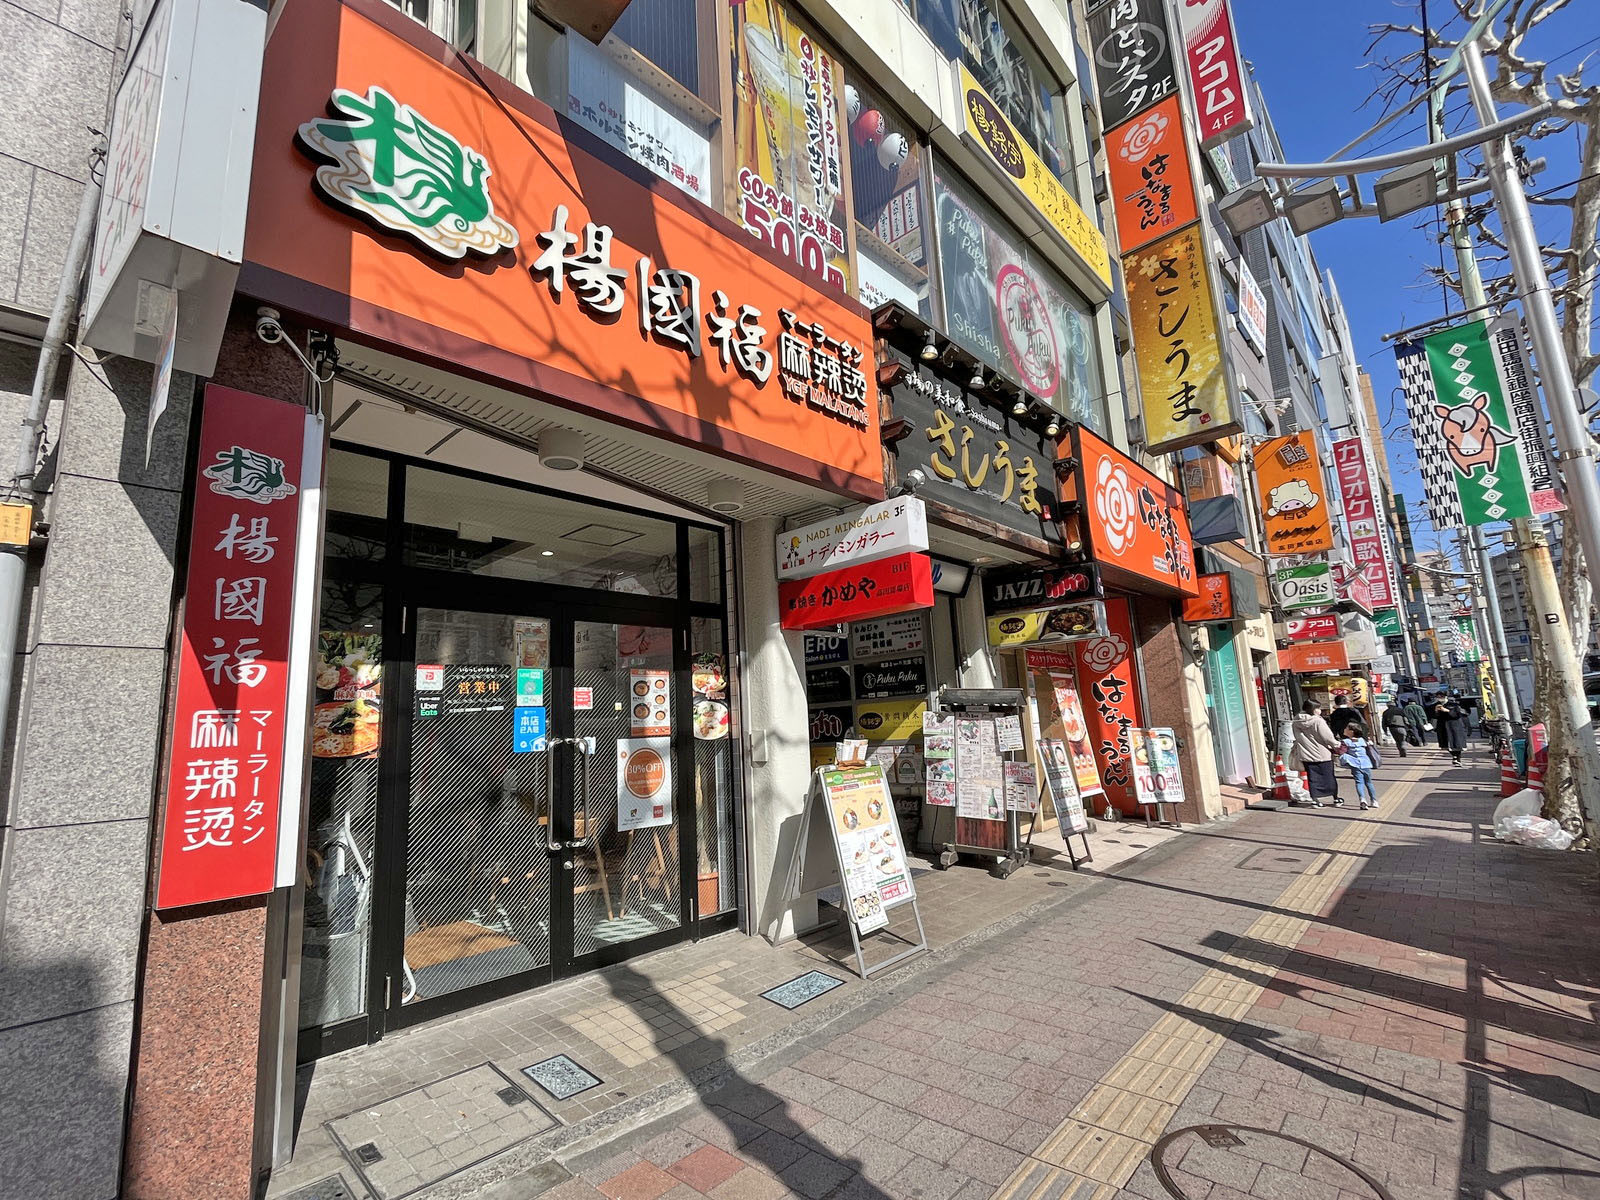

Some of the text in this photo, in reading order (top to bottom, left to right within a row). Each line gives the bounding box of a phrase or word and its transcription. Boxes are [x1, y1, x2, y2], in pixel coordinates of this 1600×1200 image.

[1151, 75, 1172, 101] 2F
[1195, 35, 1236, 116] アコム
[1211, 110, 1234, 130] 4F
[582, 106, 699, 192] ホルモン焼肉酒場
[1141, 153, 1172, 215] はなまる
[738, 167, 845, 253] 60分飲み放題
[1136, 194, 1160, 231] うどん
[531, 204, 774, 384] 楊國福
[778, 307, 864, 364] マーラータン
[953, 312, 1001, 361] Shisha
[1150, 257, 1203, 423] さしうま
[782, 373, 871, 426] YGF MALATANG
[925, 408, 1043, 515] さしうま
[1338, 443, 1370, 517] カラオケ
[806, 504, 905, 543] NADI MINGALAR 3F
[807, 531, 895, 563] ナディミンガラー
[891, 562, 909, 574] B1F
[1279, 569, 1294, 580] 3F
[201, 513, 280, 689] 楊國福
[821, 577, 877, 607] かめや
[993, 579, 1044, 602] JAZZ
[1282, 579, 1329, 598] Oasis
[1308, 619, 1334, 629] アコム
[907, 641, 922, 650] 3F
[1305, 656, 1331, 665] TBK
[458, 681, 500, 695] 営業中
[876, 670, 918, 685] Puku Puku
[915, 685, 926, 694] 2F
[420, 702, 438, 710] Uber
[520, 716, 540, 726] 本店
[1092, 673, 1133, 755] はなまる
[241, 709, 274, 846] マーラータン
[1099, 741, 1129, 787] うどん
